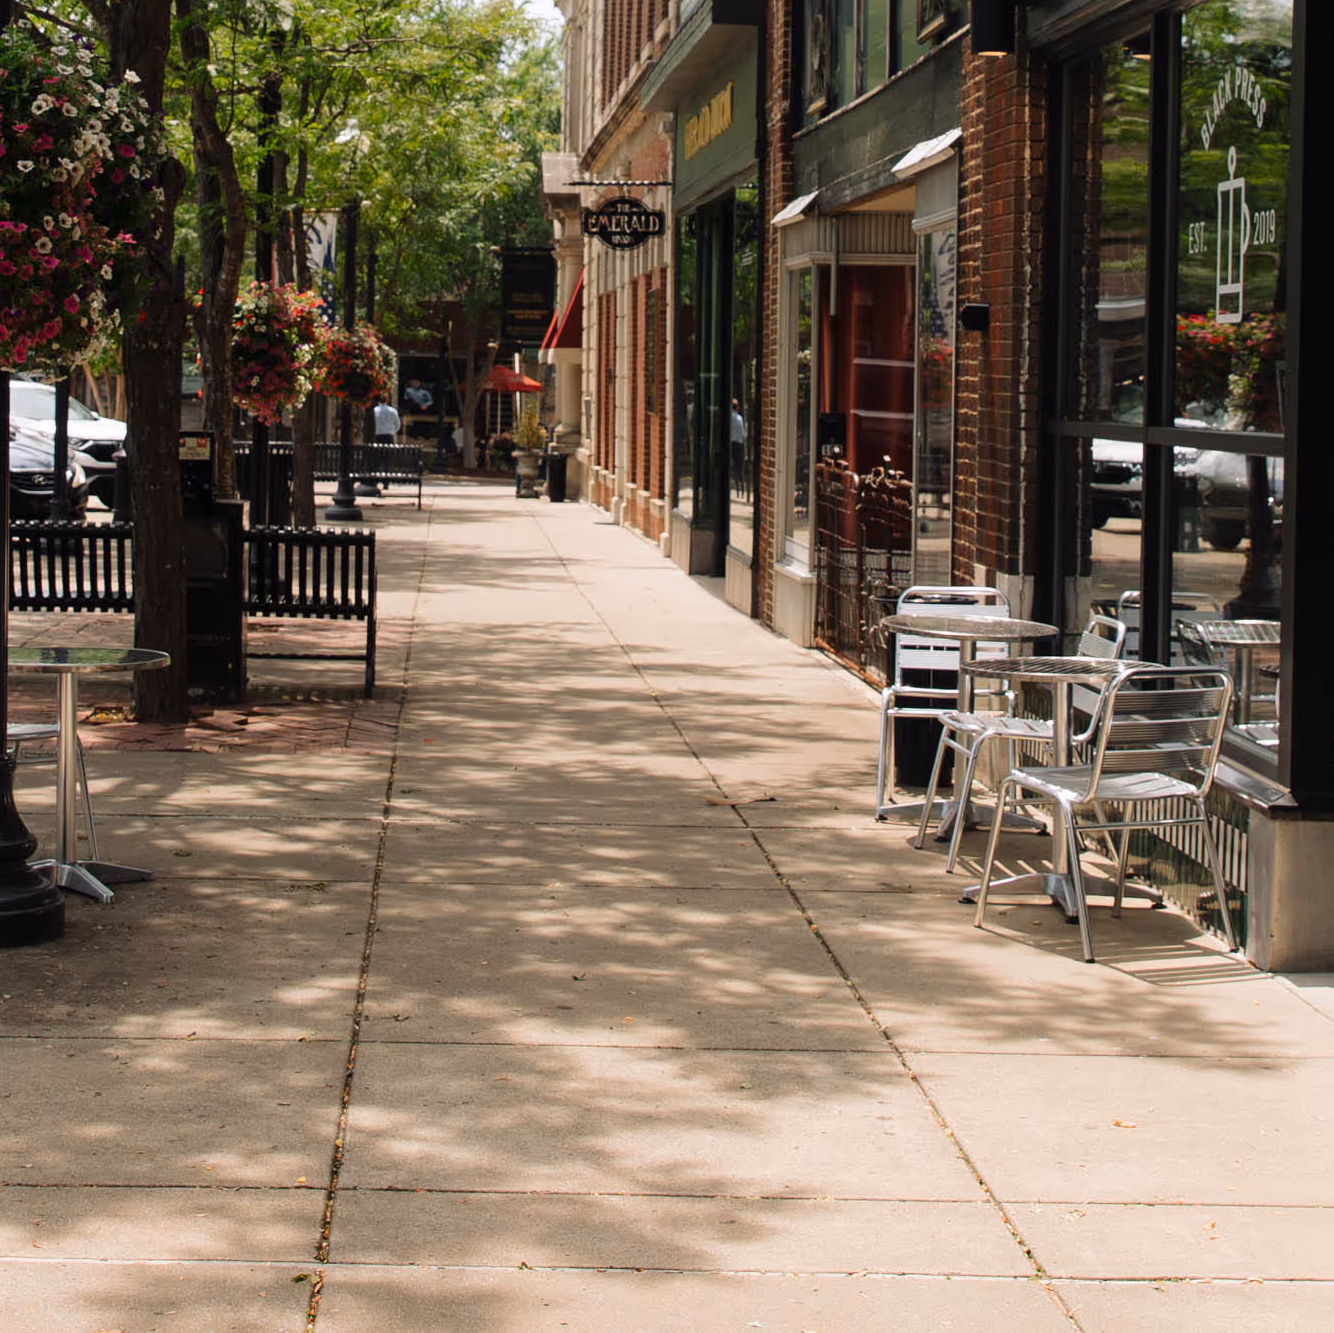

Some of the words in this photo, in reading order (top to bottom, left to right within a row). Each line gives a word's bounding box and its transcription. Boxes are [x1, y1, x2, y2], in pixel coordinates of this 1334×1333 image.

[1201, 70, 1232, 151] BLACK
[1235, 66, 1267, 129] PRESS
[588, 215, 660, 233] EMERALD
[1188, 221, 1208, 254] EST.
[1253, 209, 1276, 246] 2019
